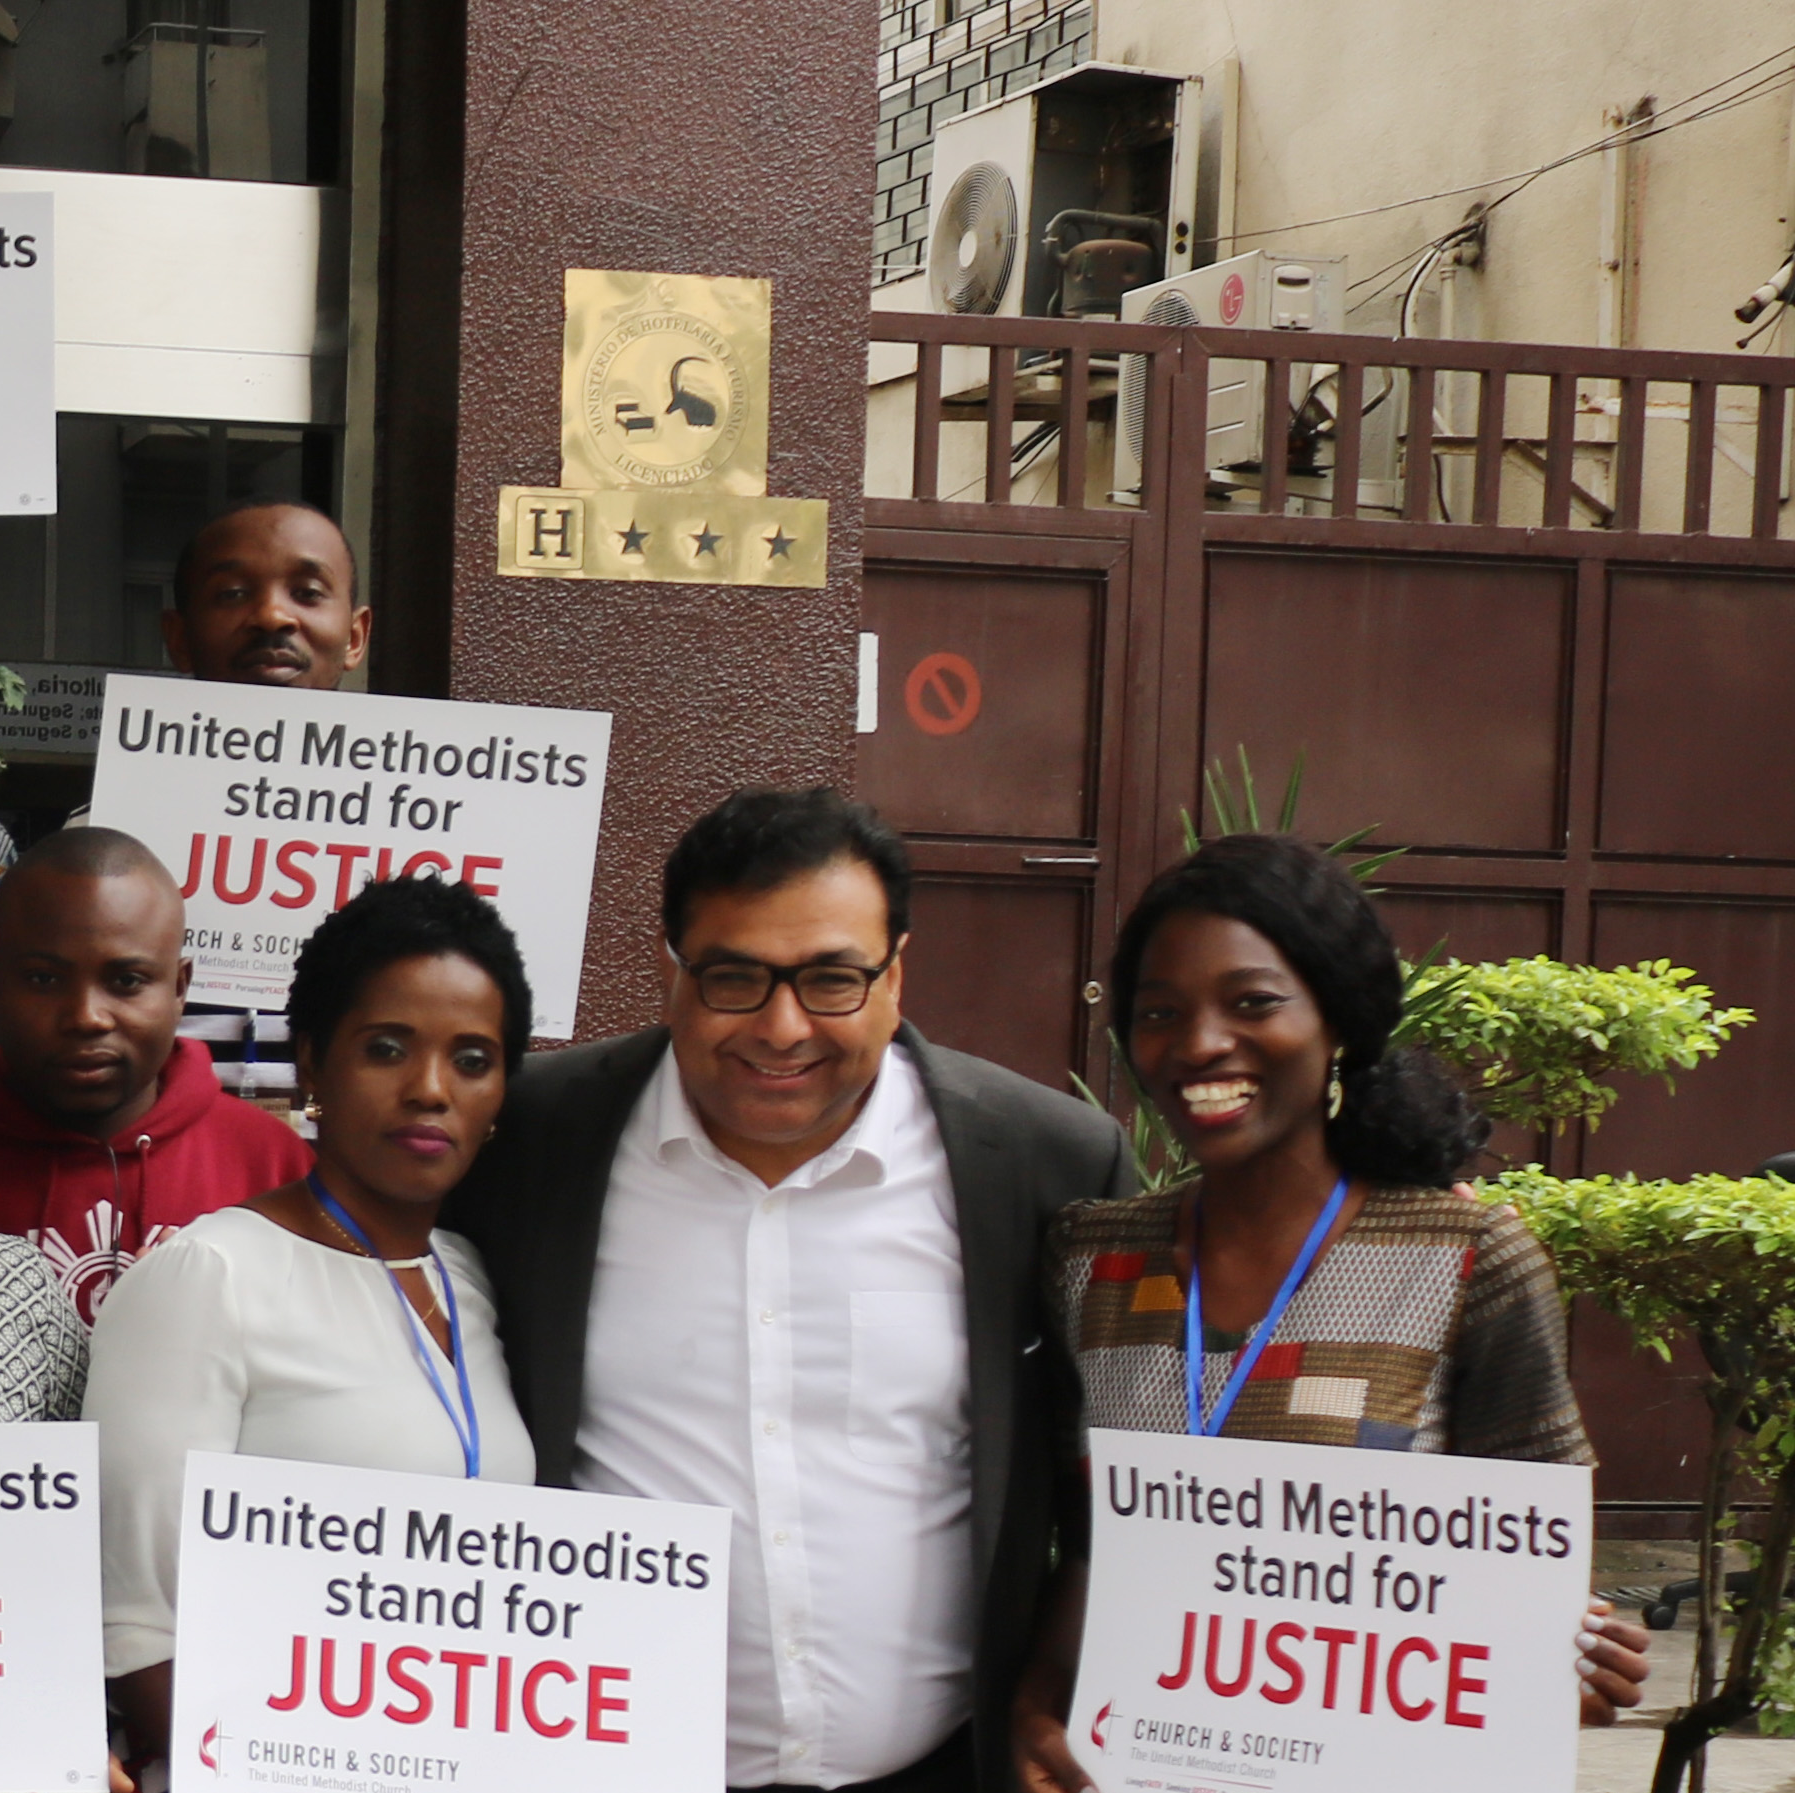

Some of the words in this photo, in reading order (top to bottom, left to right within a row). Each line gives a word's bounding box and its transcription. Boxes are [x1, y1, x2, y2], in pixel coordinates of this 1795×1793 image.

[618, 324, 638, 345] DE
[640, 317, 724, 356] HOTELARIA
[614, 453, 714, 484] LICENCIADO
[528, 508, 572, 558] H
[119, 708, 284, 762] United
[301, 722, 587, 787] Methodists
[225, 777, 371, 825] stand
[389, 784, 462, 832] for
[203, 1489, 385, 1555] United
[406, 1510, 708, 1589] Methodists
[1109, 1465, 1262, 1528] United
[1283, 1480, 1570, 1558] Methodists
[326, 1572, 483, 1629] stand
[504, 1584, 581, 1638] for
[1214, 1546, 1353, 1604] stand
[1373, 1555, 1445, 1614] for
[267, 1636, 629, 1743] JUSTICE
[1157, 1612, 1489, 1729] JUSTICE
[249, 1740, 335, 1769] CHURCH
[347, 1751, 358, 1771] &
[370, 1753, 459, 1781] SOCIETY
